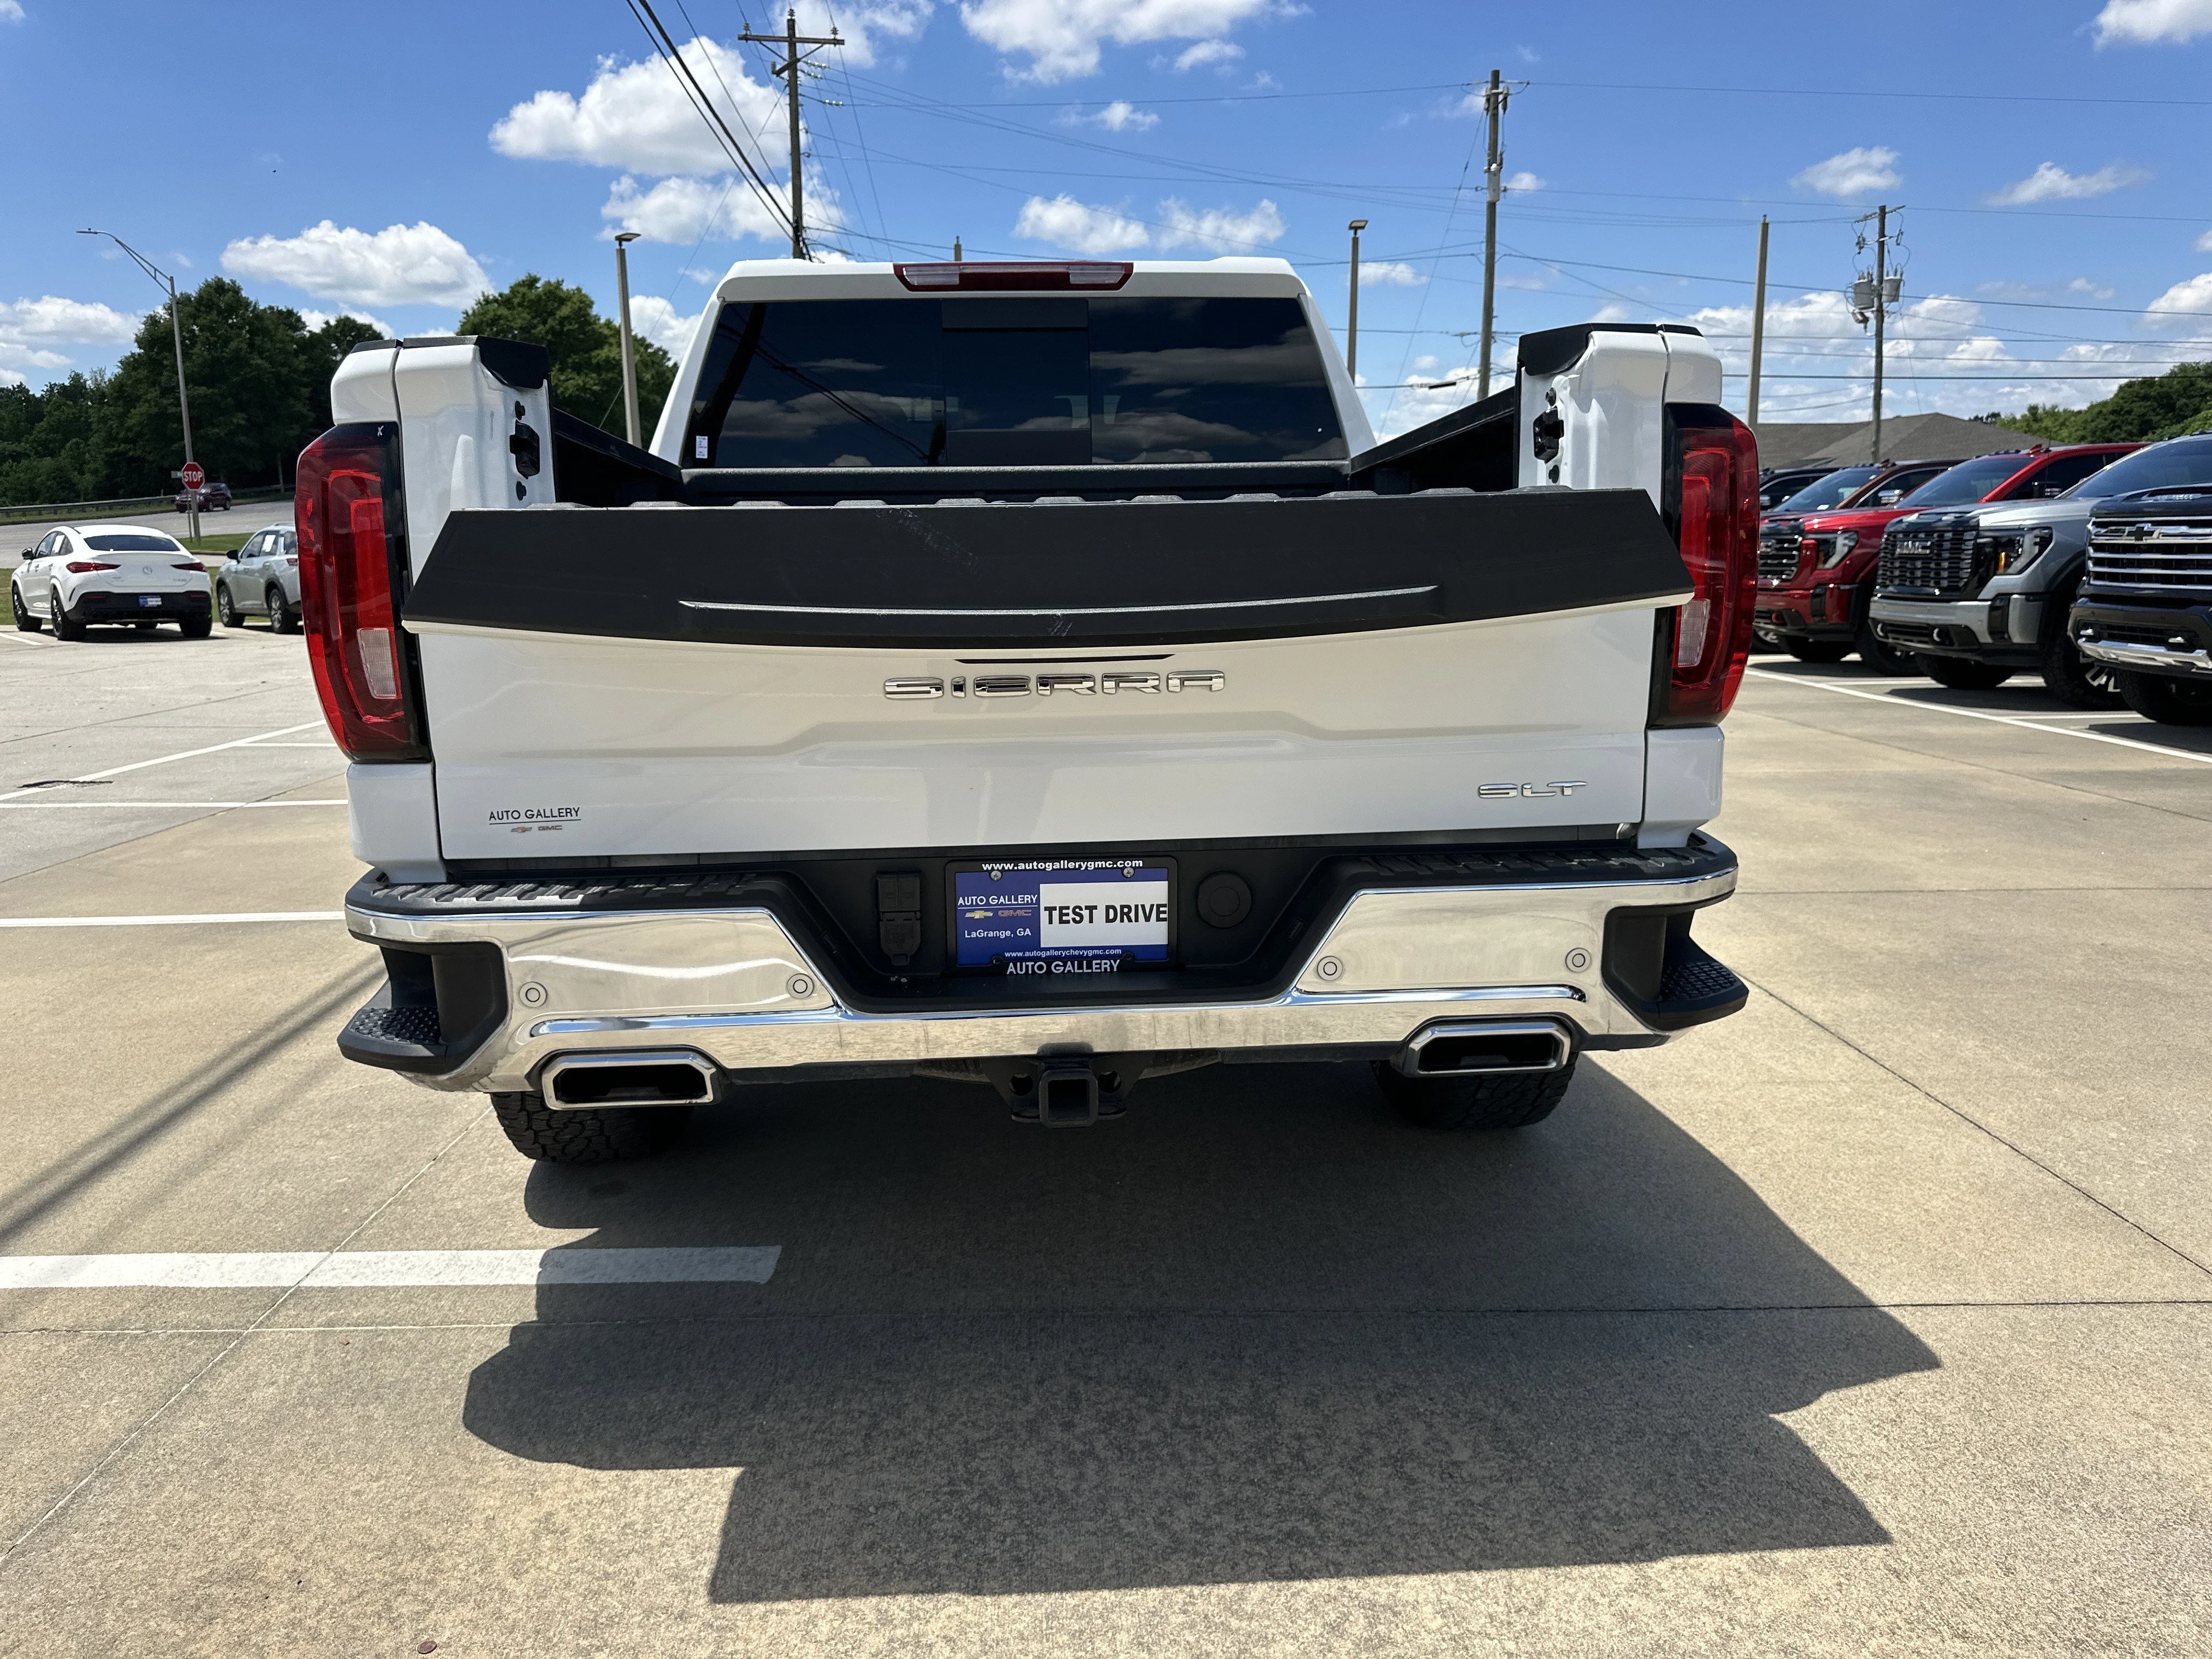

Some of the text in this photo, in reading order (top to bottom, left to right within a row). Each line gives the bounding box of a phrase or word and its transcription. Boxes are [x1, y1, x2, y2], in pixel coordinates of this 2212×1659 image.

[184, 471, 202, 482] STOP
[884, 670, 1226, 699] SIERRA
[1479, 781, 1588, 798] SLT
[489, 807, 580, 821] AUTO GALLERY
[982, 860, 1143, 871] www.autogallerygmc.com
[958, 894, 1038, 906] AUTO GALLERY
[1044, 903, 1167, 925] TEST DRIVE
[964, 930, 1014, 939] LaGrange,
[1005, 948, 1121, 958] www.autogallerychevygmc.com
[1007, 960, 1120, 975] AUTO GALLERY
